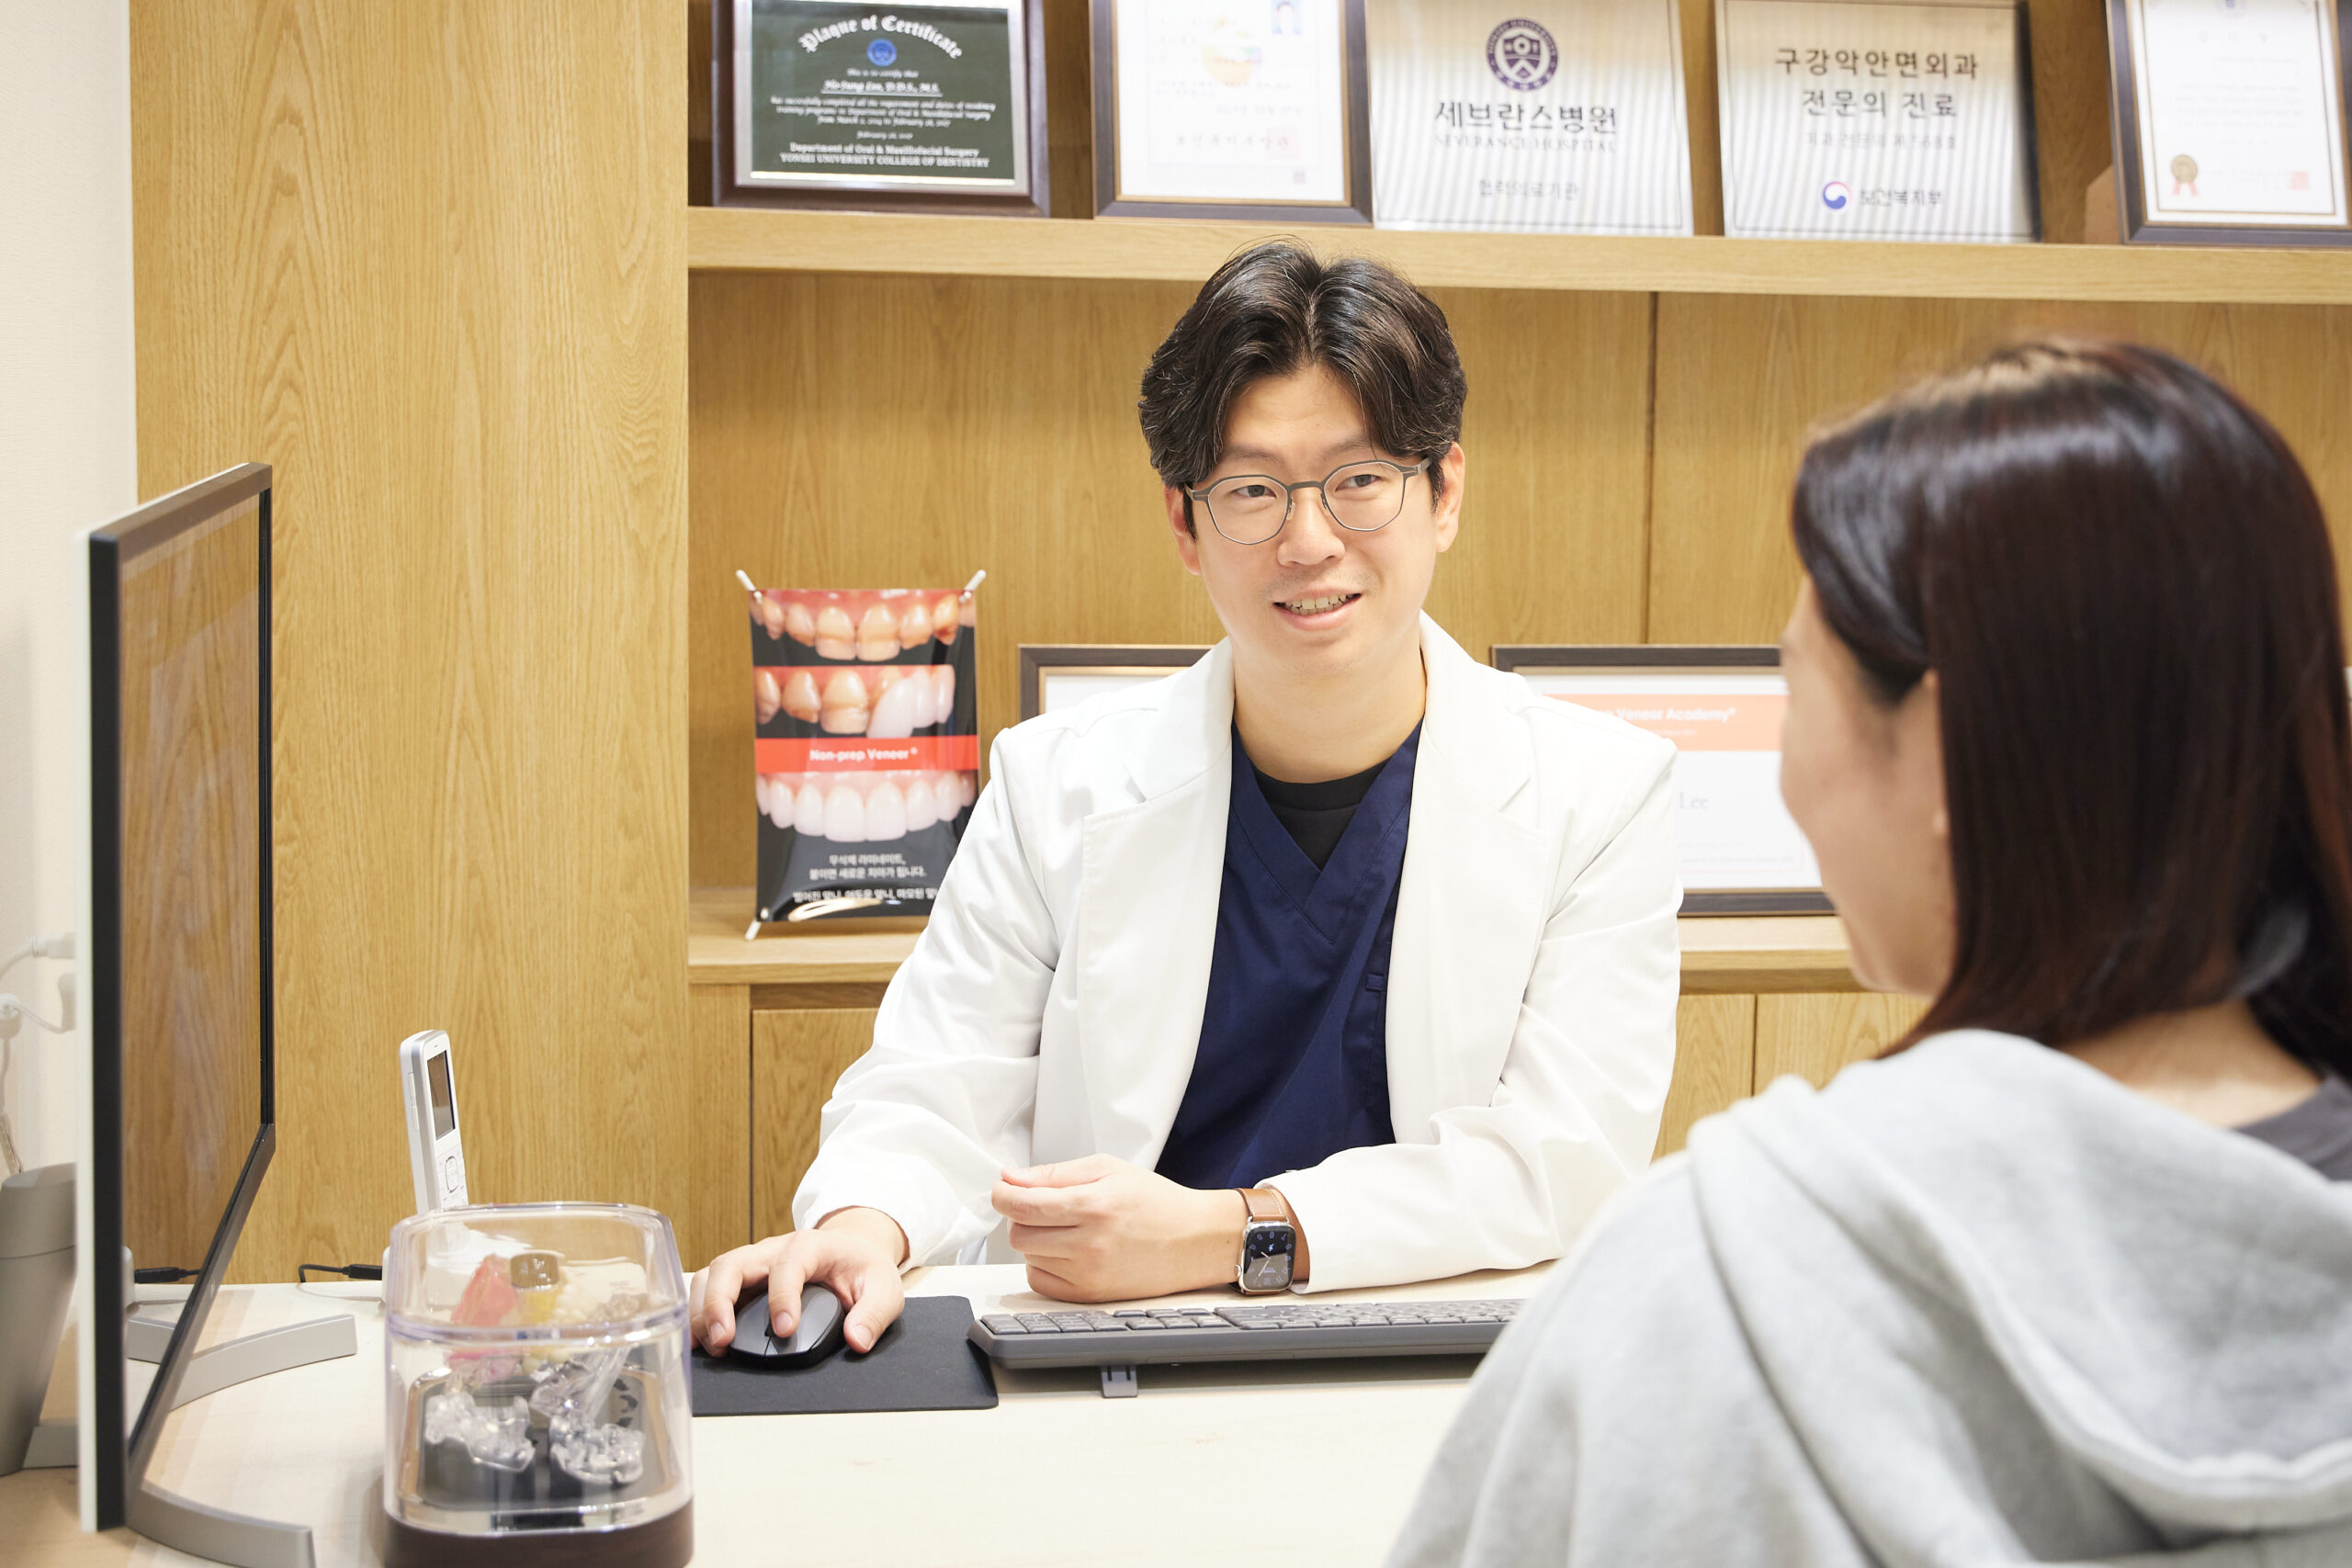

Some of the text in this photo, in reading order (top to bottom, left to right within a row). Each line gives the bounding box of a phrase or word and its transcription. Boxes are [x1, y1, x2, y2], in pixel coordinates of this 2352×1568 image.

[797, 14, 962, 59] Plaque of Certificate
[1775, 48, 1978, 80] 구강악안면외과
[1435, 101, 1616, 134] 세브란스병원
[1802, 90, 1957, 118] 전문의 진료
[816, 153, 876, 165] UNIVERSITY
[876, 154, 921, 166] COLLEGE
[936, 156, 989, 168] DENTISTRY
[1860, 189, 1942, 208] 보건복지부
[809, 749, 865, 762] Non-prep
